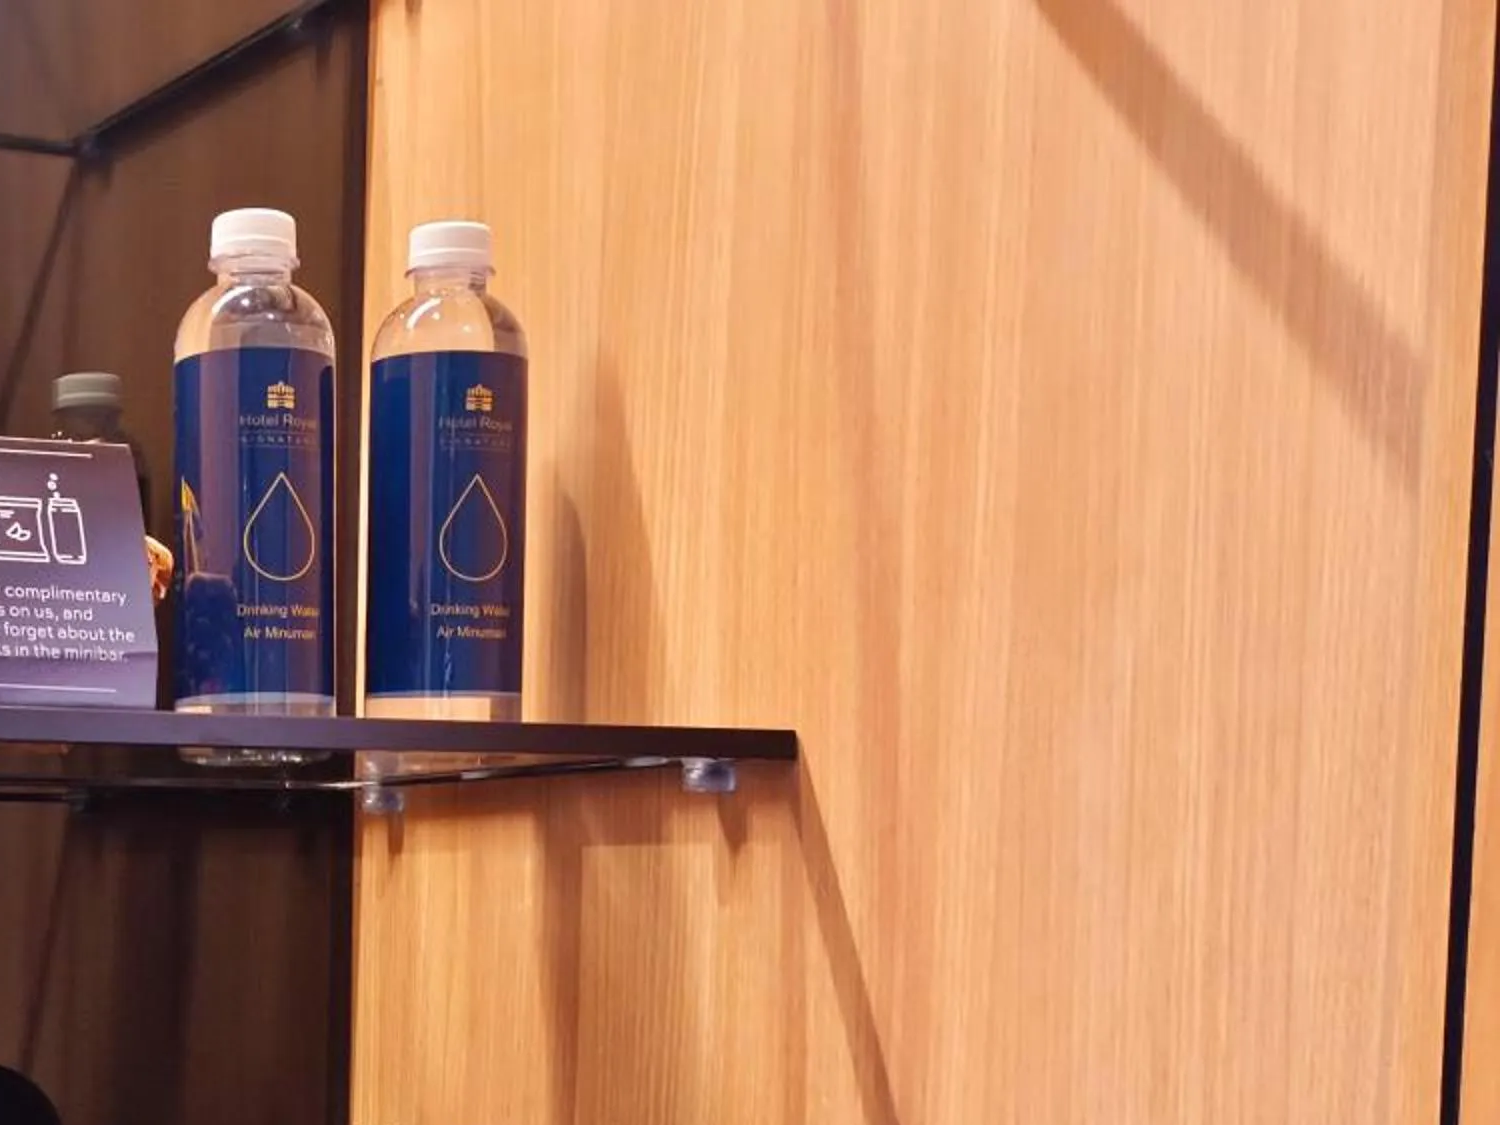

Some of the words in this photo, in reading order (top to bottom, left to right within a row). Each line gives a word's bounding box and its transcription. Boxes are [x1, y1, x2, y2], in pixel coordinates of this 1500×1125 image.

[4, 585, 127, 606] complimentary
[9, 605, 30, 617] on
[34, 607, 59, 621] us,
[63, 608, 93, 621] and
[3, 621, 54, 641] forget
[57, 626, 105, 641] about
[109, 628, 135, 643] the
[244, 625, 260, 639] Air
[436, 625, 455, 639] Air
[15, 645, 29, 657] in
[34, 644, 61, 659] the
[64, 646, 128, 662] minibar.
